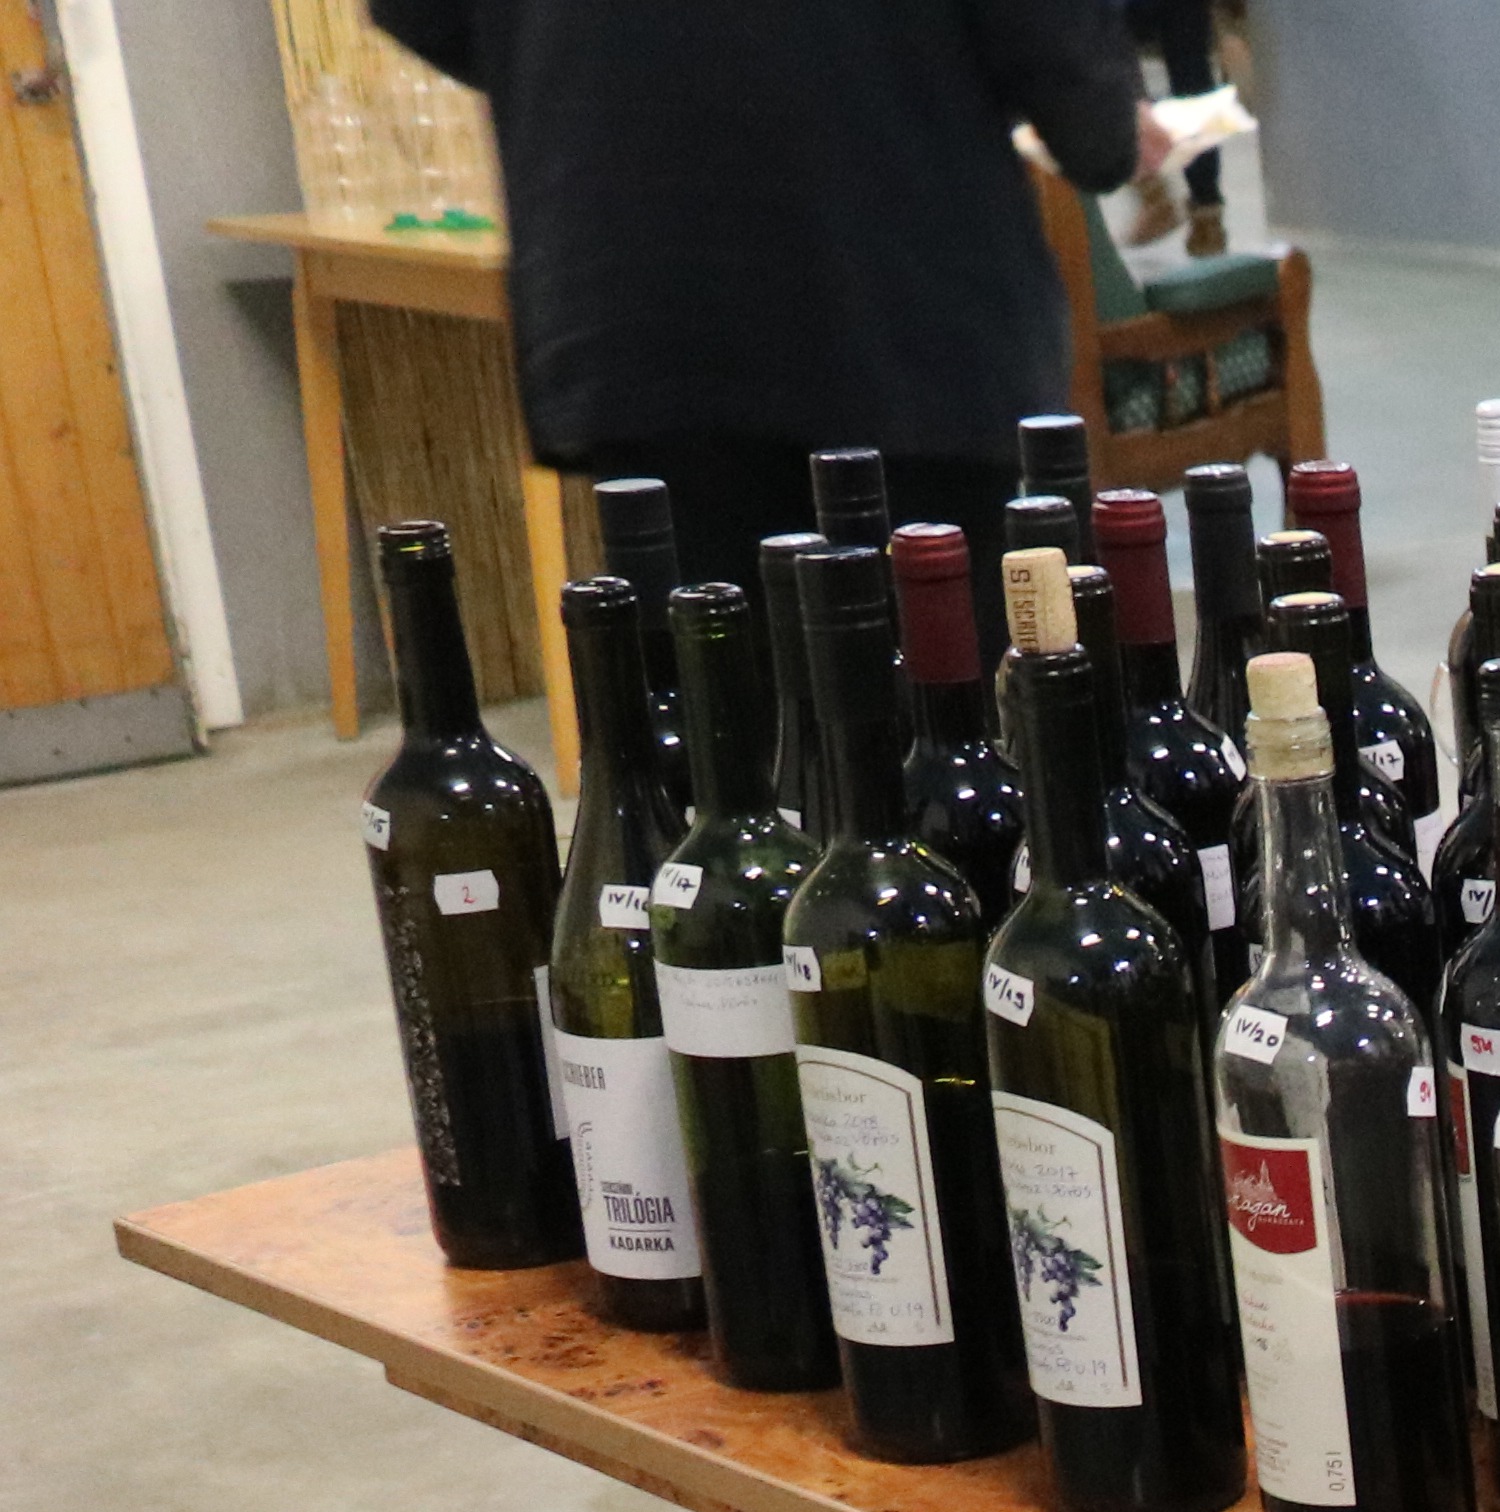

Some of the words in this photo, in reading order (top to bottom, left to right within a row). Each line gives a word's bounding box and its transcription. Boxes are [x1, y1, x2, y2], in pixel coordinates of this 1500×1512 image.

[462, 885, 477, 904] 2
[1235, 1017, 1279, 1047] IV/20
[602, 1192, 675, 1225] TRILÓGIA
[608, 1234, 675, 1252] KADARKA
